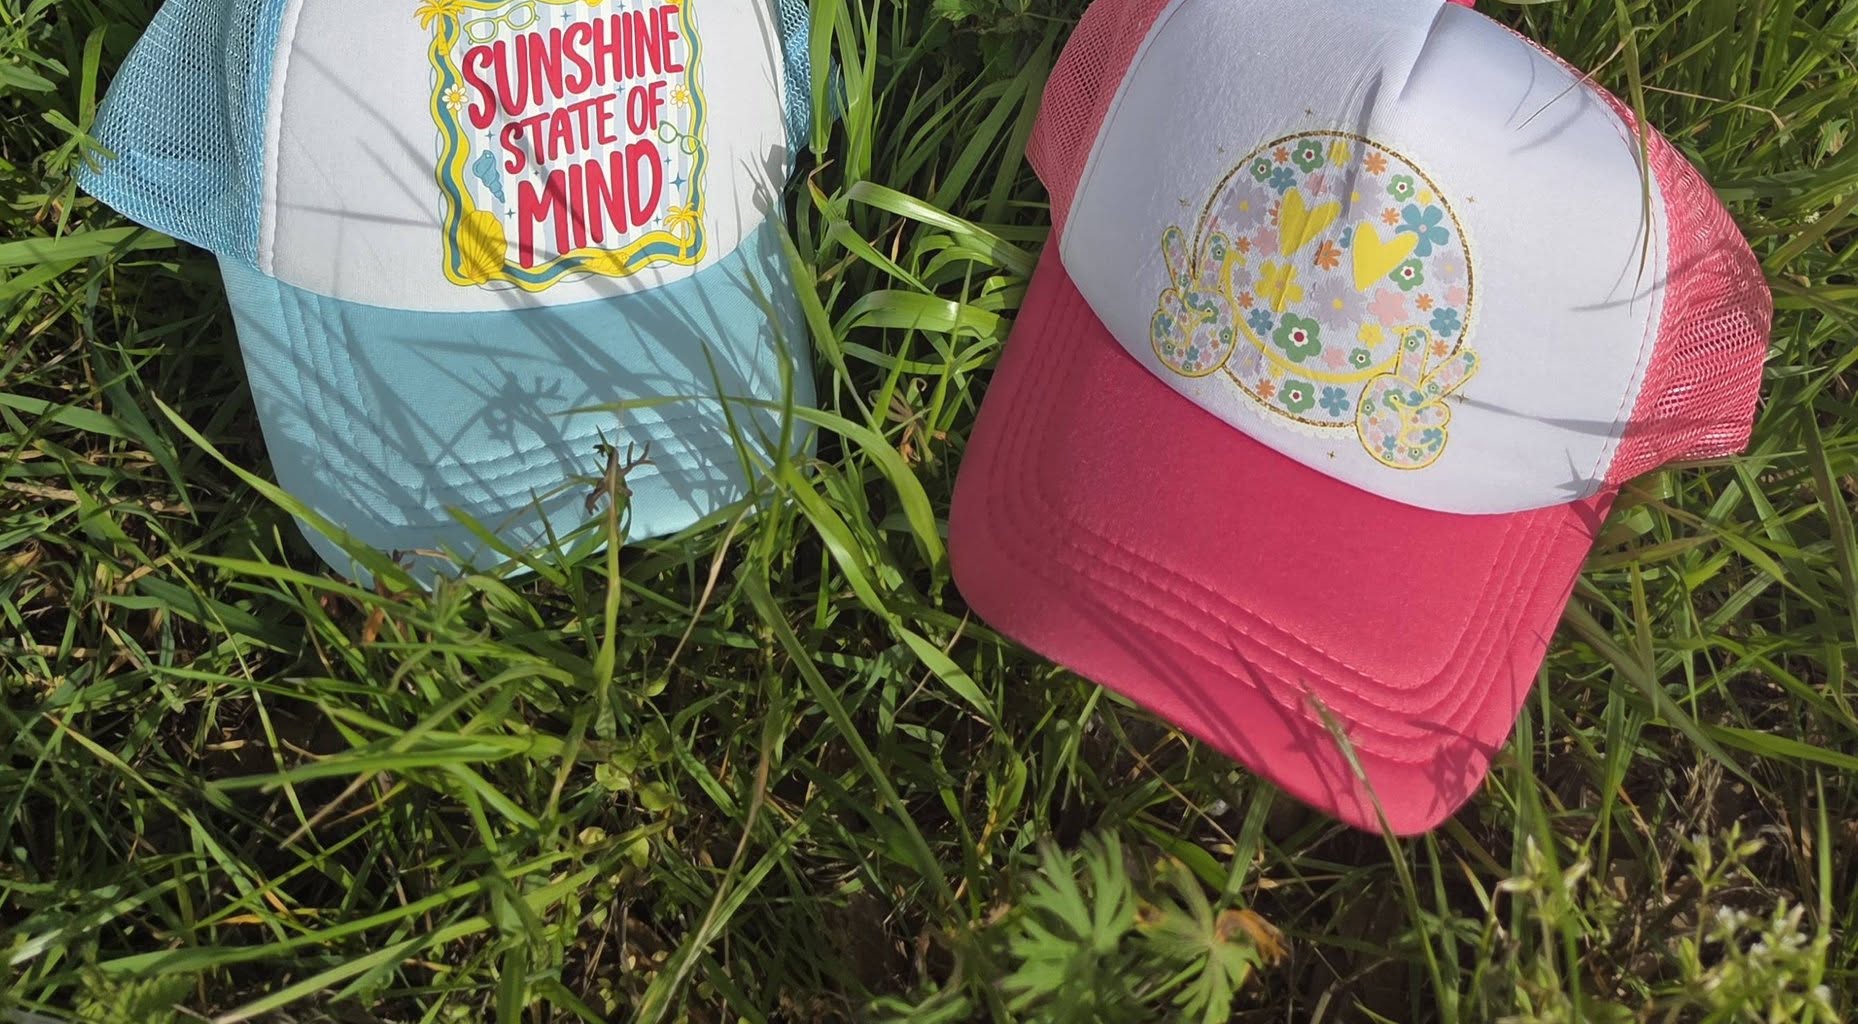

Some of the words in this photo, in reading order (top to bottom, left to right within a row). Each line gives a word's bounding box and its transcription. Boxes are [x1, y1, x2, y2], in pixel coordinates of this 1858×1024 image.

[462, 4, 684, 130] SUNSHINE
[500, 93, 618, 174] STATE
[626, 80, 667, 136] OF
[517, 139, 663, 268] MIND
